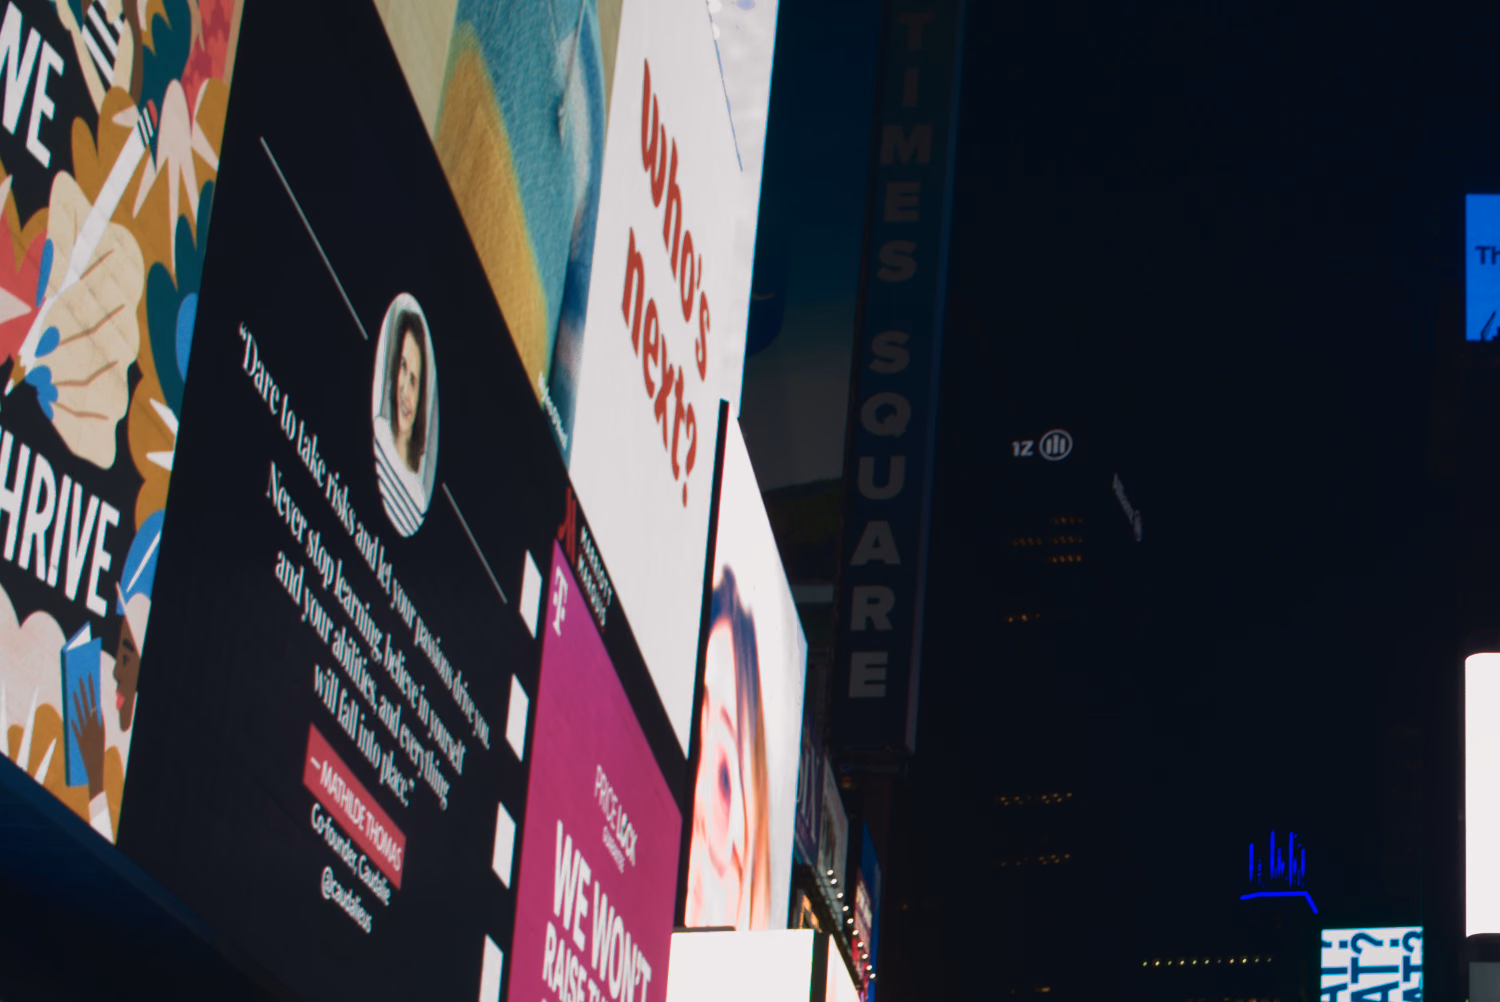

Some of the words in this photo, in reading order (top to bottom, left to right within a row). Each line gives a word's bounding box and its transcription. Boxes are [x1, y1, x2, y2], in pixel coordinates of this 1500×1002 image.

[641, 58, 711, 382] who's
[876, 12, 936, 283] TIMES
[621, 226, 698, 508] next?
[0, 424, 121, 618] HRIVE
[264, 459, 308, 545] Never
[306, 528, 335, 591] stop
[383, 632, 419, 710] believe
[417, 684, 430, 727] in
[427, 708, 467, 776] yourself
[274, 550, 305, 607] and
[301, 585, 334, 646] your
[378, 694, 402, 740] and
[281, 392, 297, 442] to
[297, 418, 326, 488] take
[325, 471, 357, 537] risks
[355, 520, 380, 573] and
[377, 545, 393, 596] let
[390, 577, 417, 630] your
[452, 669, 476, 724] drive
[848, 329, 912, 699] SQUARE
[313, 663, 340, 715] will
[336, 687, 360, 741] fall
[357, 712, 381, 770] into
[319, 759, 368, 832] MATHILDE
[365, 810, 403, 873] THOMAS
[552, 818, 592, 952] WE
